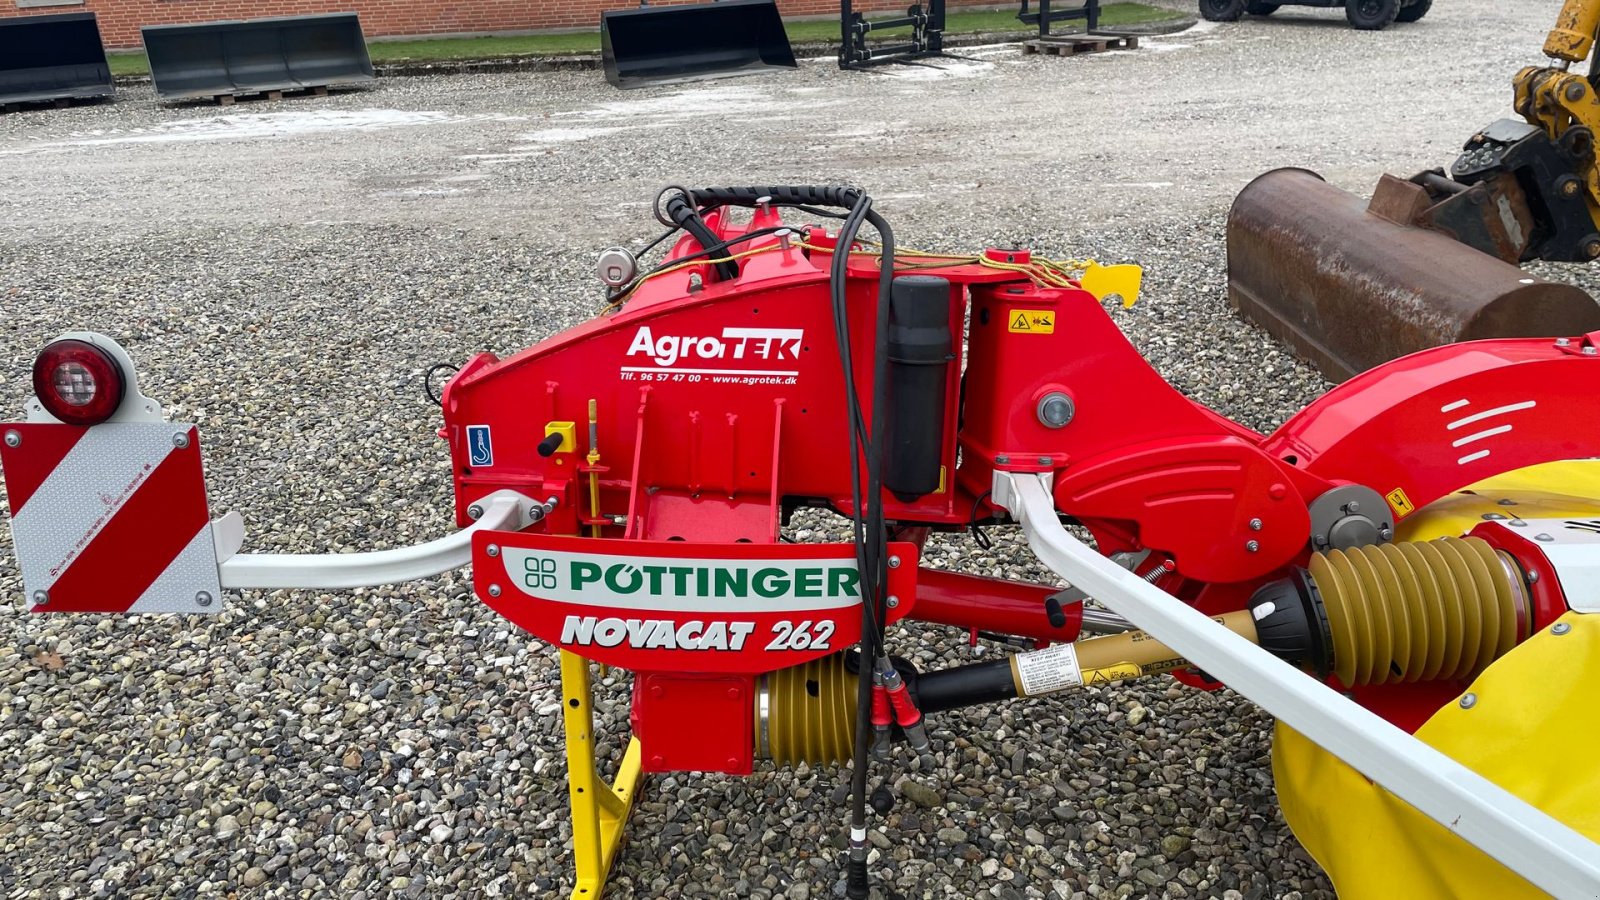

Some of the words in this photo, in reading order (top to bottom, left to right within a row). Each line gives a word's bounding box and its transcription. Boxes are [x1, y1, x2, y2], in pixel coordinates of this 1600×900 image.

[620, 372, 637, 381] Tlf.
[640, 373, 653, 381] 96
[656, 374, 669, 382] 57
[672, 374, 685, 382] 47
[688, 375, 701, 383] 00
[712, 376, 798, 386] www.agrotek.dk
[570, 561, 860, 598] PÖTTINGER
[560, 615, 755, 651] NOVACAT
[764, 619, 836, 651] 262
